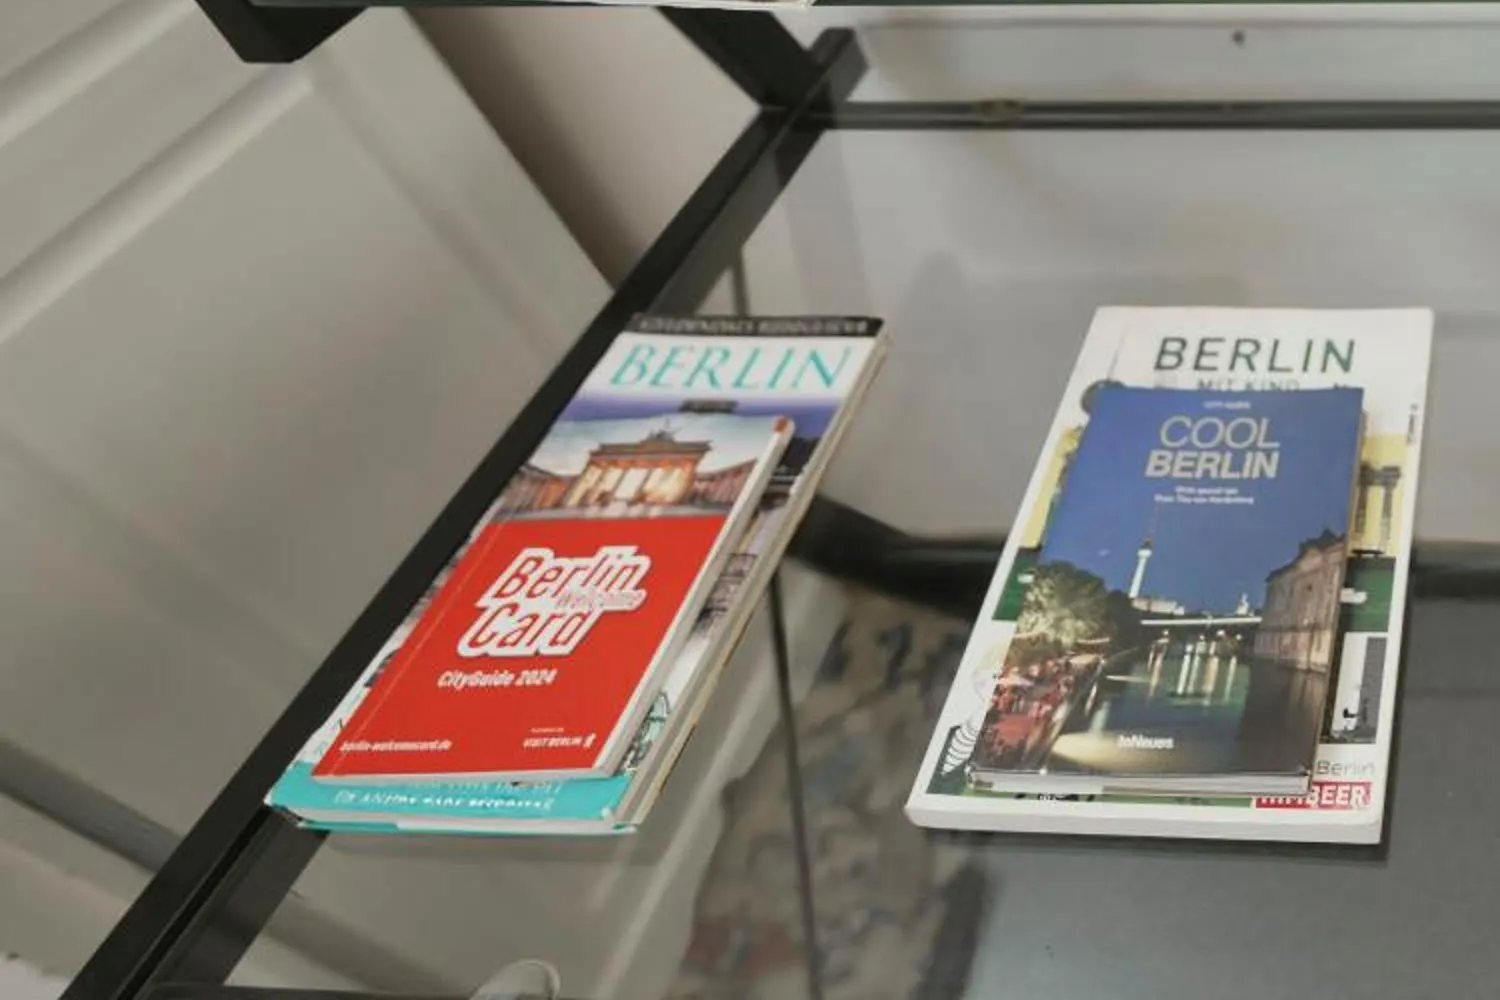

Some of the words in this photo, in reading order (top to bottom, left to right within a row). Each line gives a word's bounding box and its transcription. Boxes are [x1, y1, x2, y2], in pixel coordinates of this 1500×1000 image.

[610, 343, 852, 389] BERLIN
[1153, 336, 1356, 373] BERLIN
[1160, 415, 1280, 449] COOL
[1145, 450, 1280, 479] BERLIN
[493, 553, 641, 599] Berlin
[468, 601, 592, 649] Card
[515, 668, 557, 686] 2024
[1314, 760, 1375, 776] Berlin
